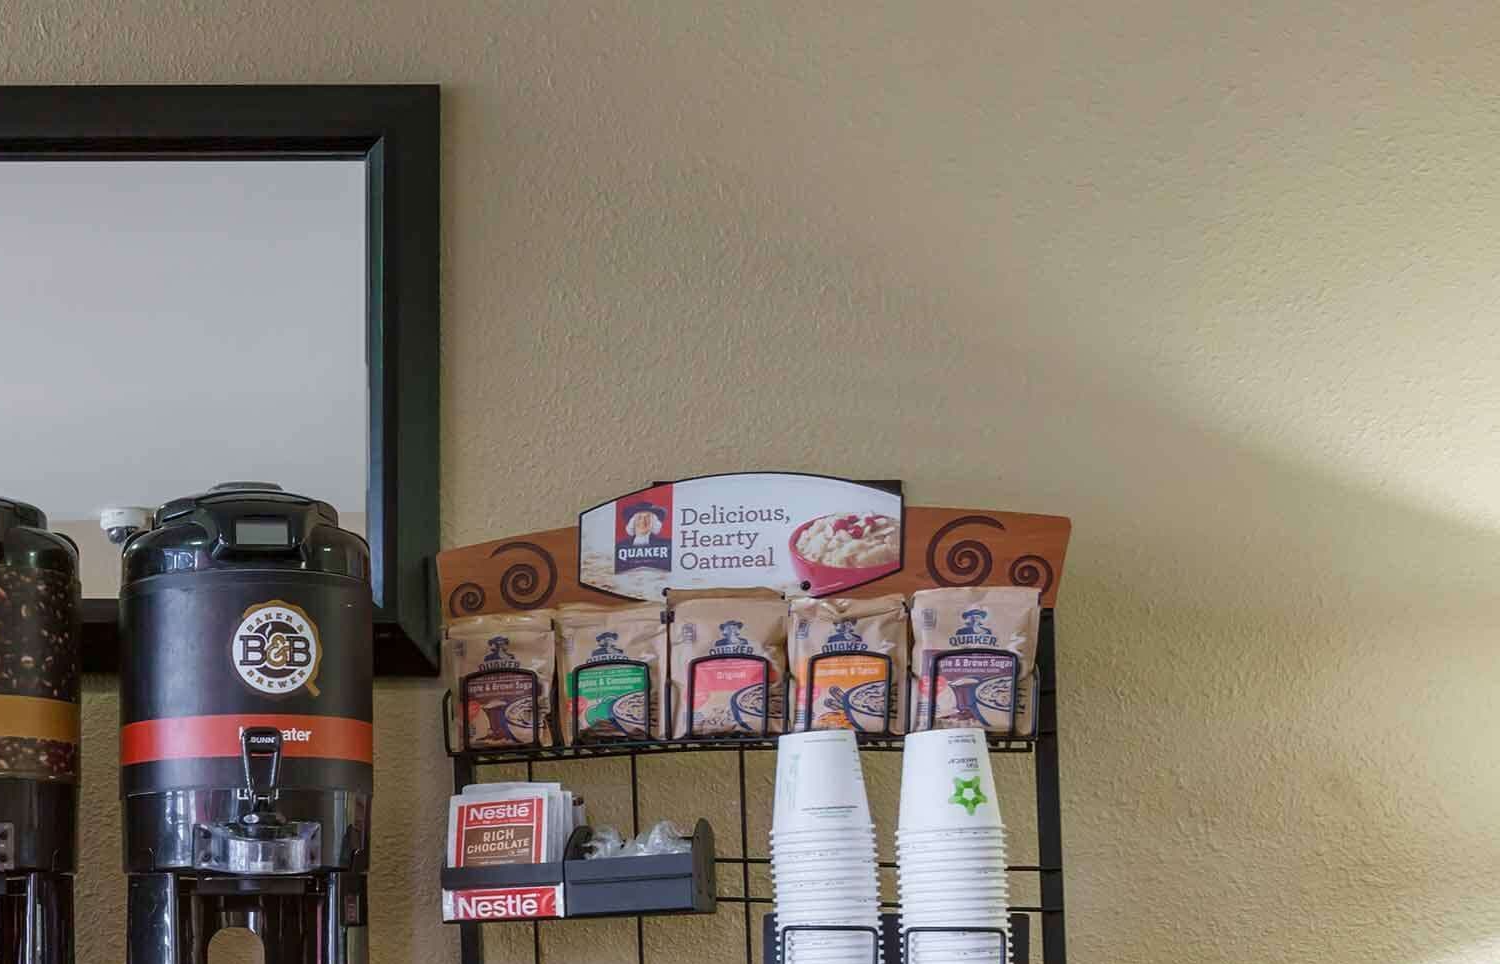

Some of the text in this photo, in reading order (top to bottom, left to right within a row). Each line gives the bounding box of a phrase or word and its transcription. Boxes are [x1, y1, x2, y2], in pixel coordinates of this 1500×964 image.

[680, 505, 791, 526] Delicious,
[680, 530, 759, 550] Hearty
[618, 546, 669, 561] QUAKER
[680, 547, 776, 570] Oatmeal
[949, 635, 998, 647] QUAKER
[280, 727, 312, 742] ater
[483, 829, 515, 842] RICH
[467, 838, 530, 855] CHOCOLATE
